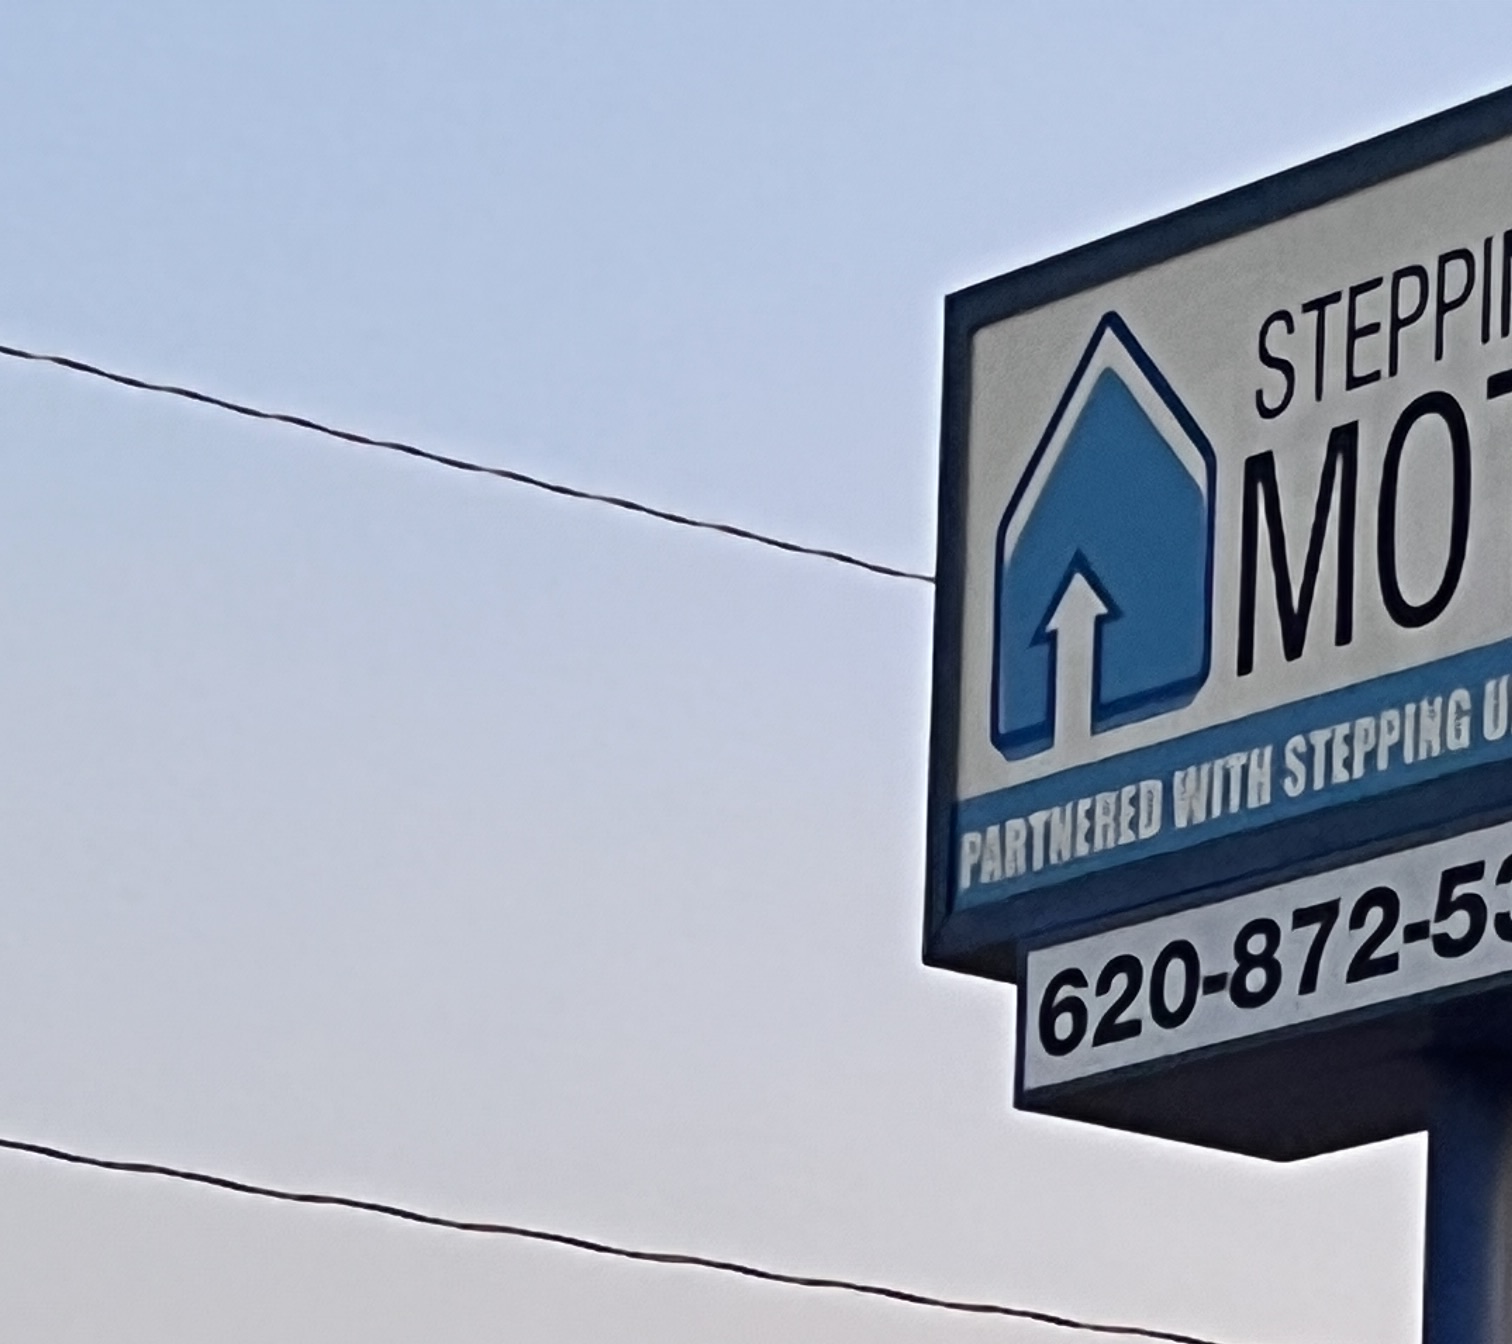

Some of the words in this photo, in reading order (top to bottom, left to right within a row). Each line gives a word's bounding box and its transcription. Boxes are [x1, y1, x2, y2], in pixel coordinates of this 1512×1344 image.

[960, 779, 1163, 889] PARTNERED
[1173, 744, 1273, 828] WITH
[1283, 687, 1471, 798] STEPPING
